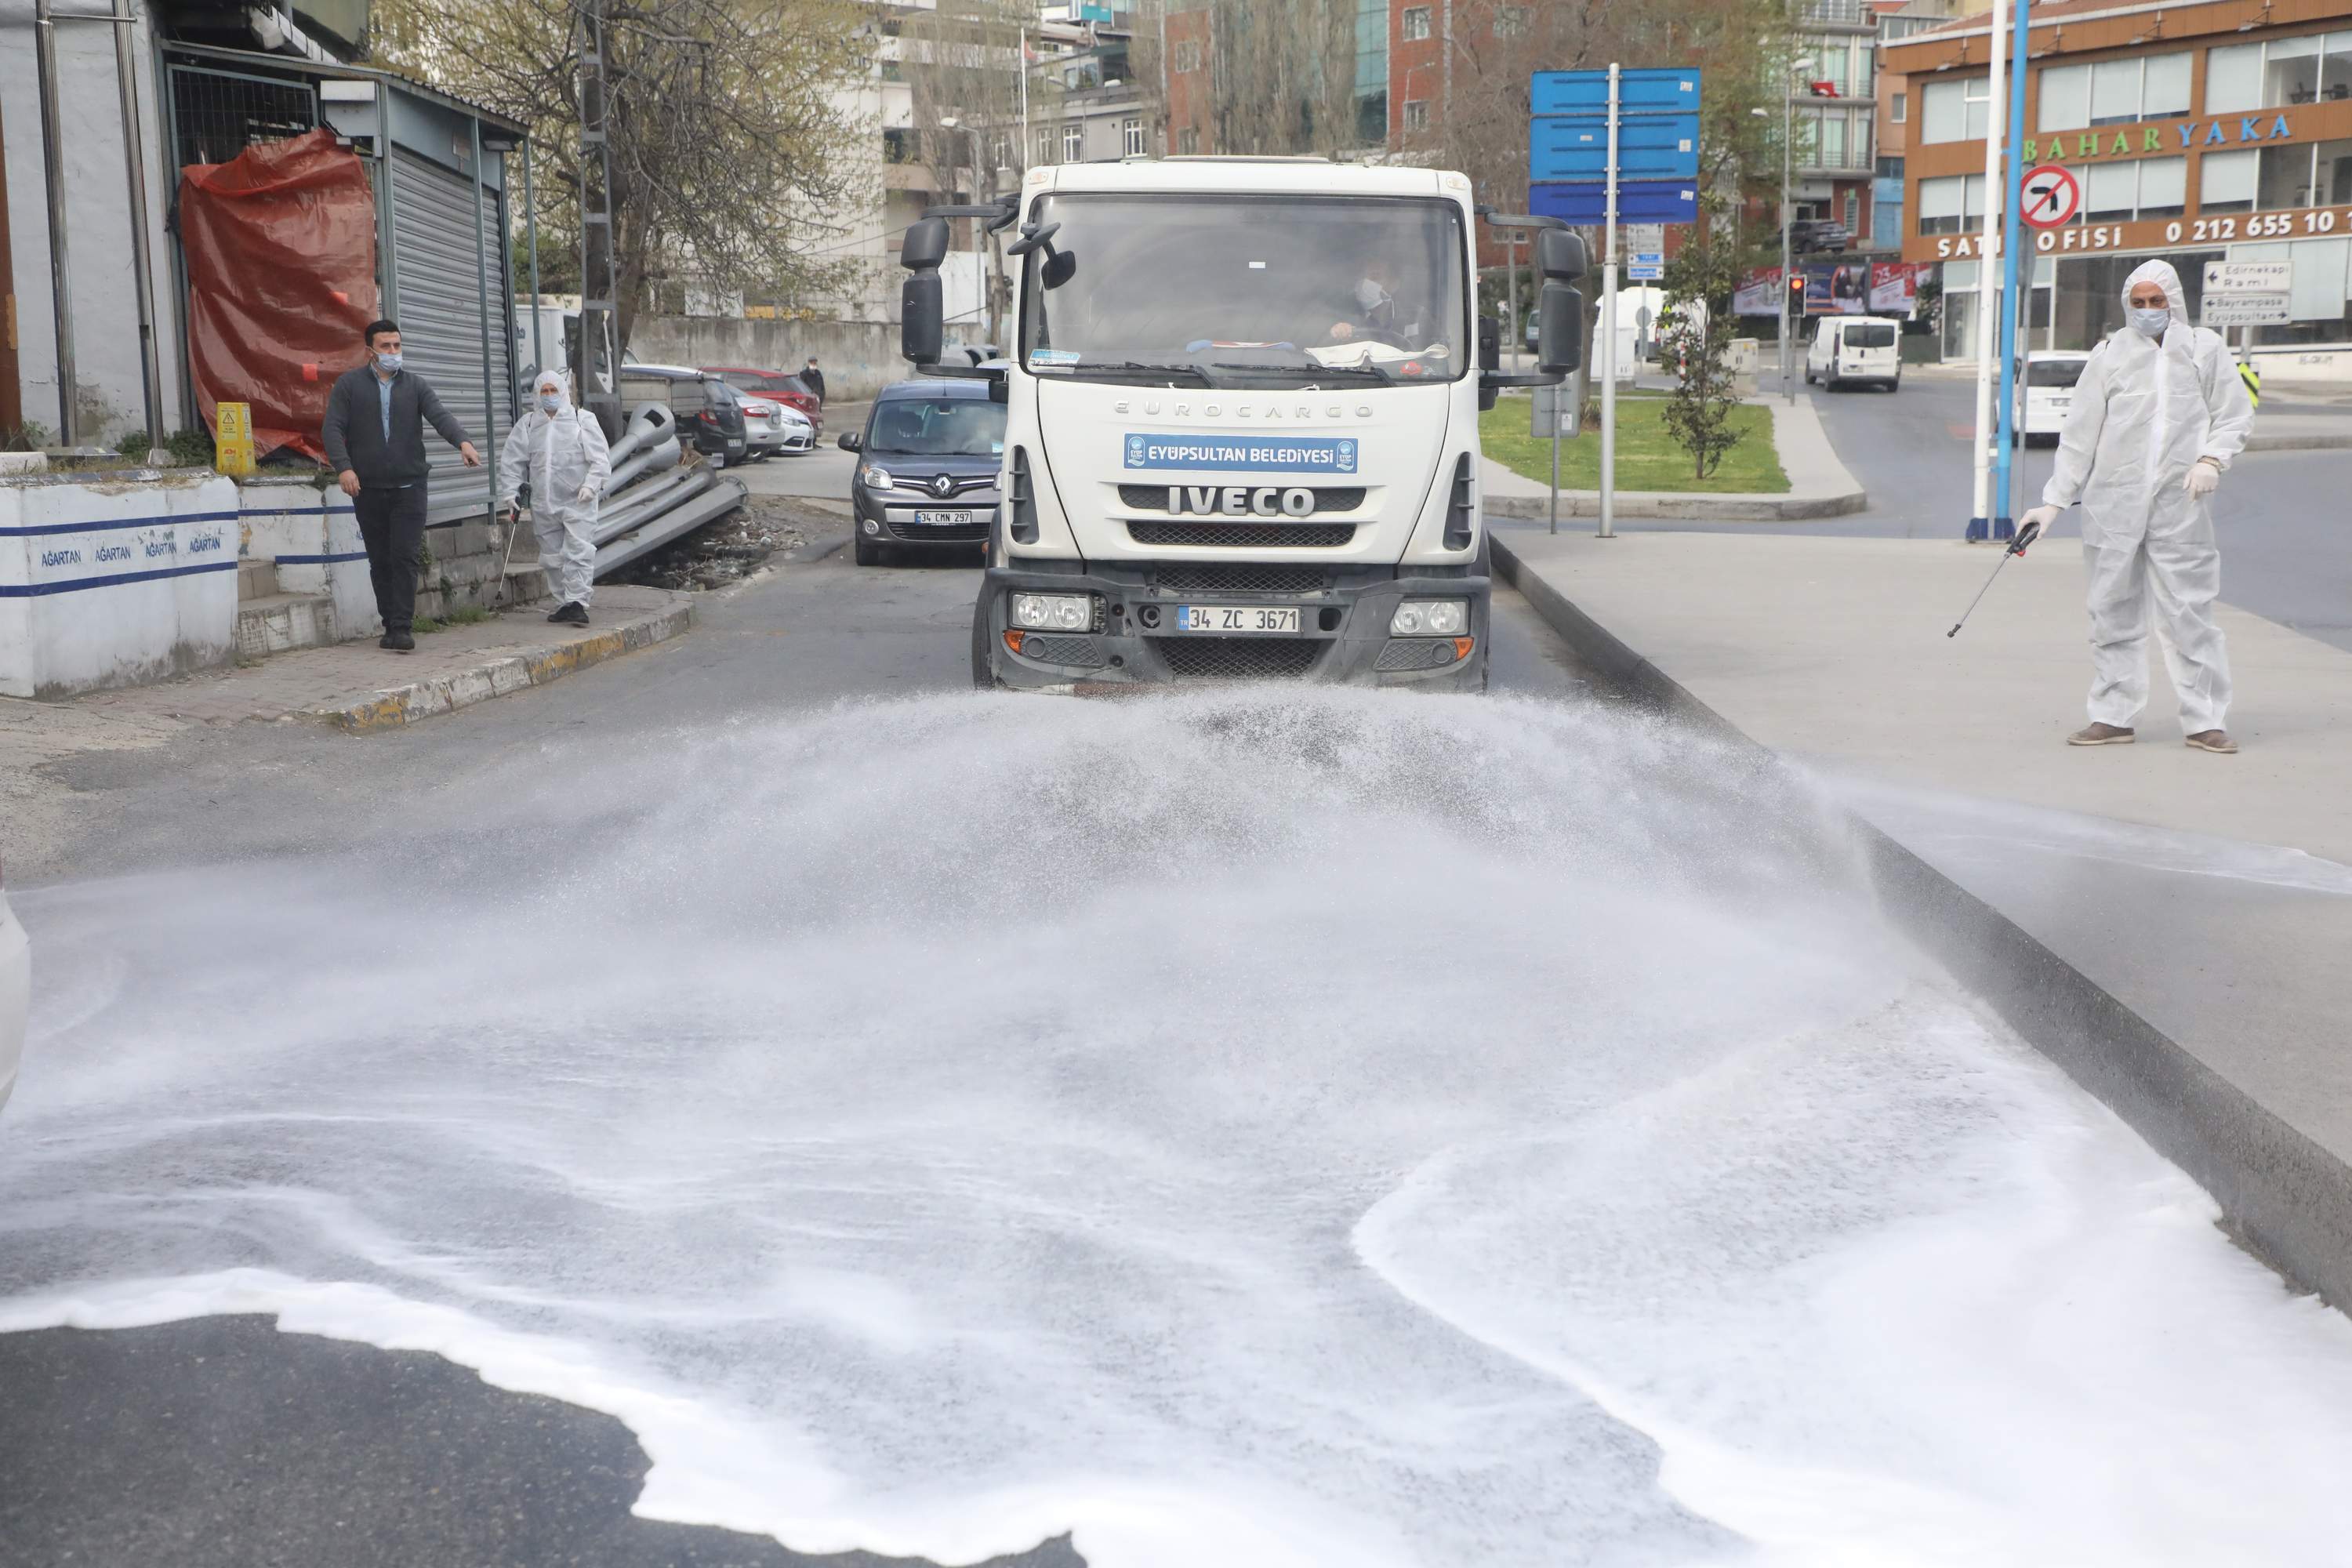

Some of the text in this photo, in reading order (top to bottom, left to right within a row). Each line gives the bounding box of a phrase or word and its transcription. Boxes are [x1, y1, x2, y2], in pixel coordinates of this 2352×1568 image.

[2023, 114, 2292, 162] BAHAR YAKA
[2166, 222, 2183, 242] 0
[2192, 218, 2236, 241] 212
[2246, 213, 2292, 236] 655
[2304, 211, 2335, 233] 10
[2223, 278, 2268, 287] Rami
[1114, 400, 1373, 418] EUROCARGO
[1148, 445, 1246, 463] EYÜPSULTAN
[1168, 486, 1316, 517] IVECO
[921, 513, 969, 522] 34 CMN 297
[41, 537, 221, 567] AĞARTAN AĞARTAN AĞARTAN AĞARTAN
[1190, 609, 1211, 629] 34
[1222, 609, 1243, 629] ZC
[1256, 610, 1297, 630] 3671
